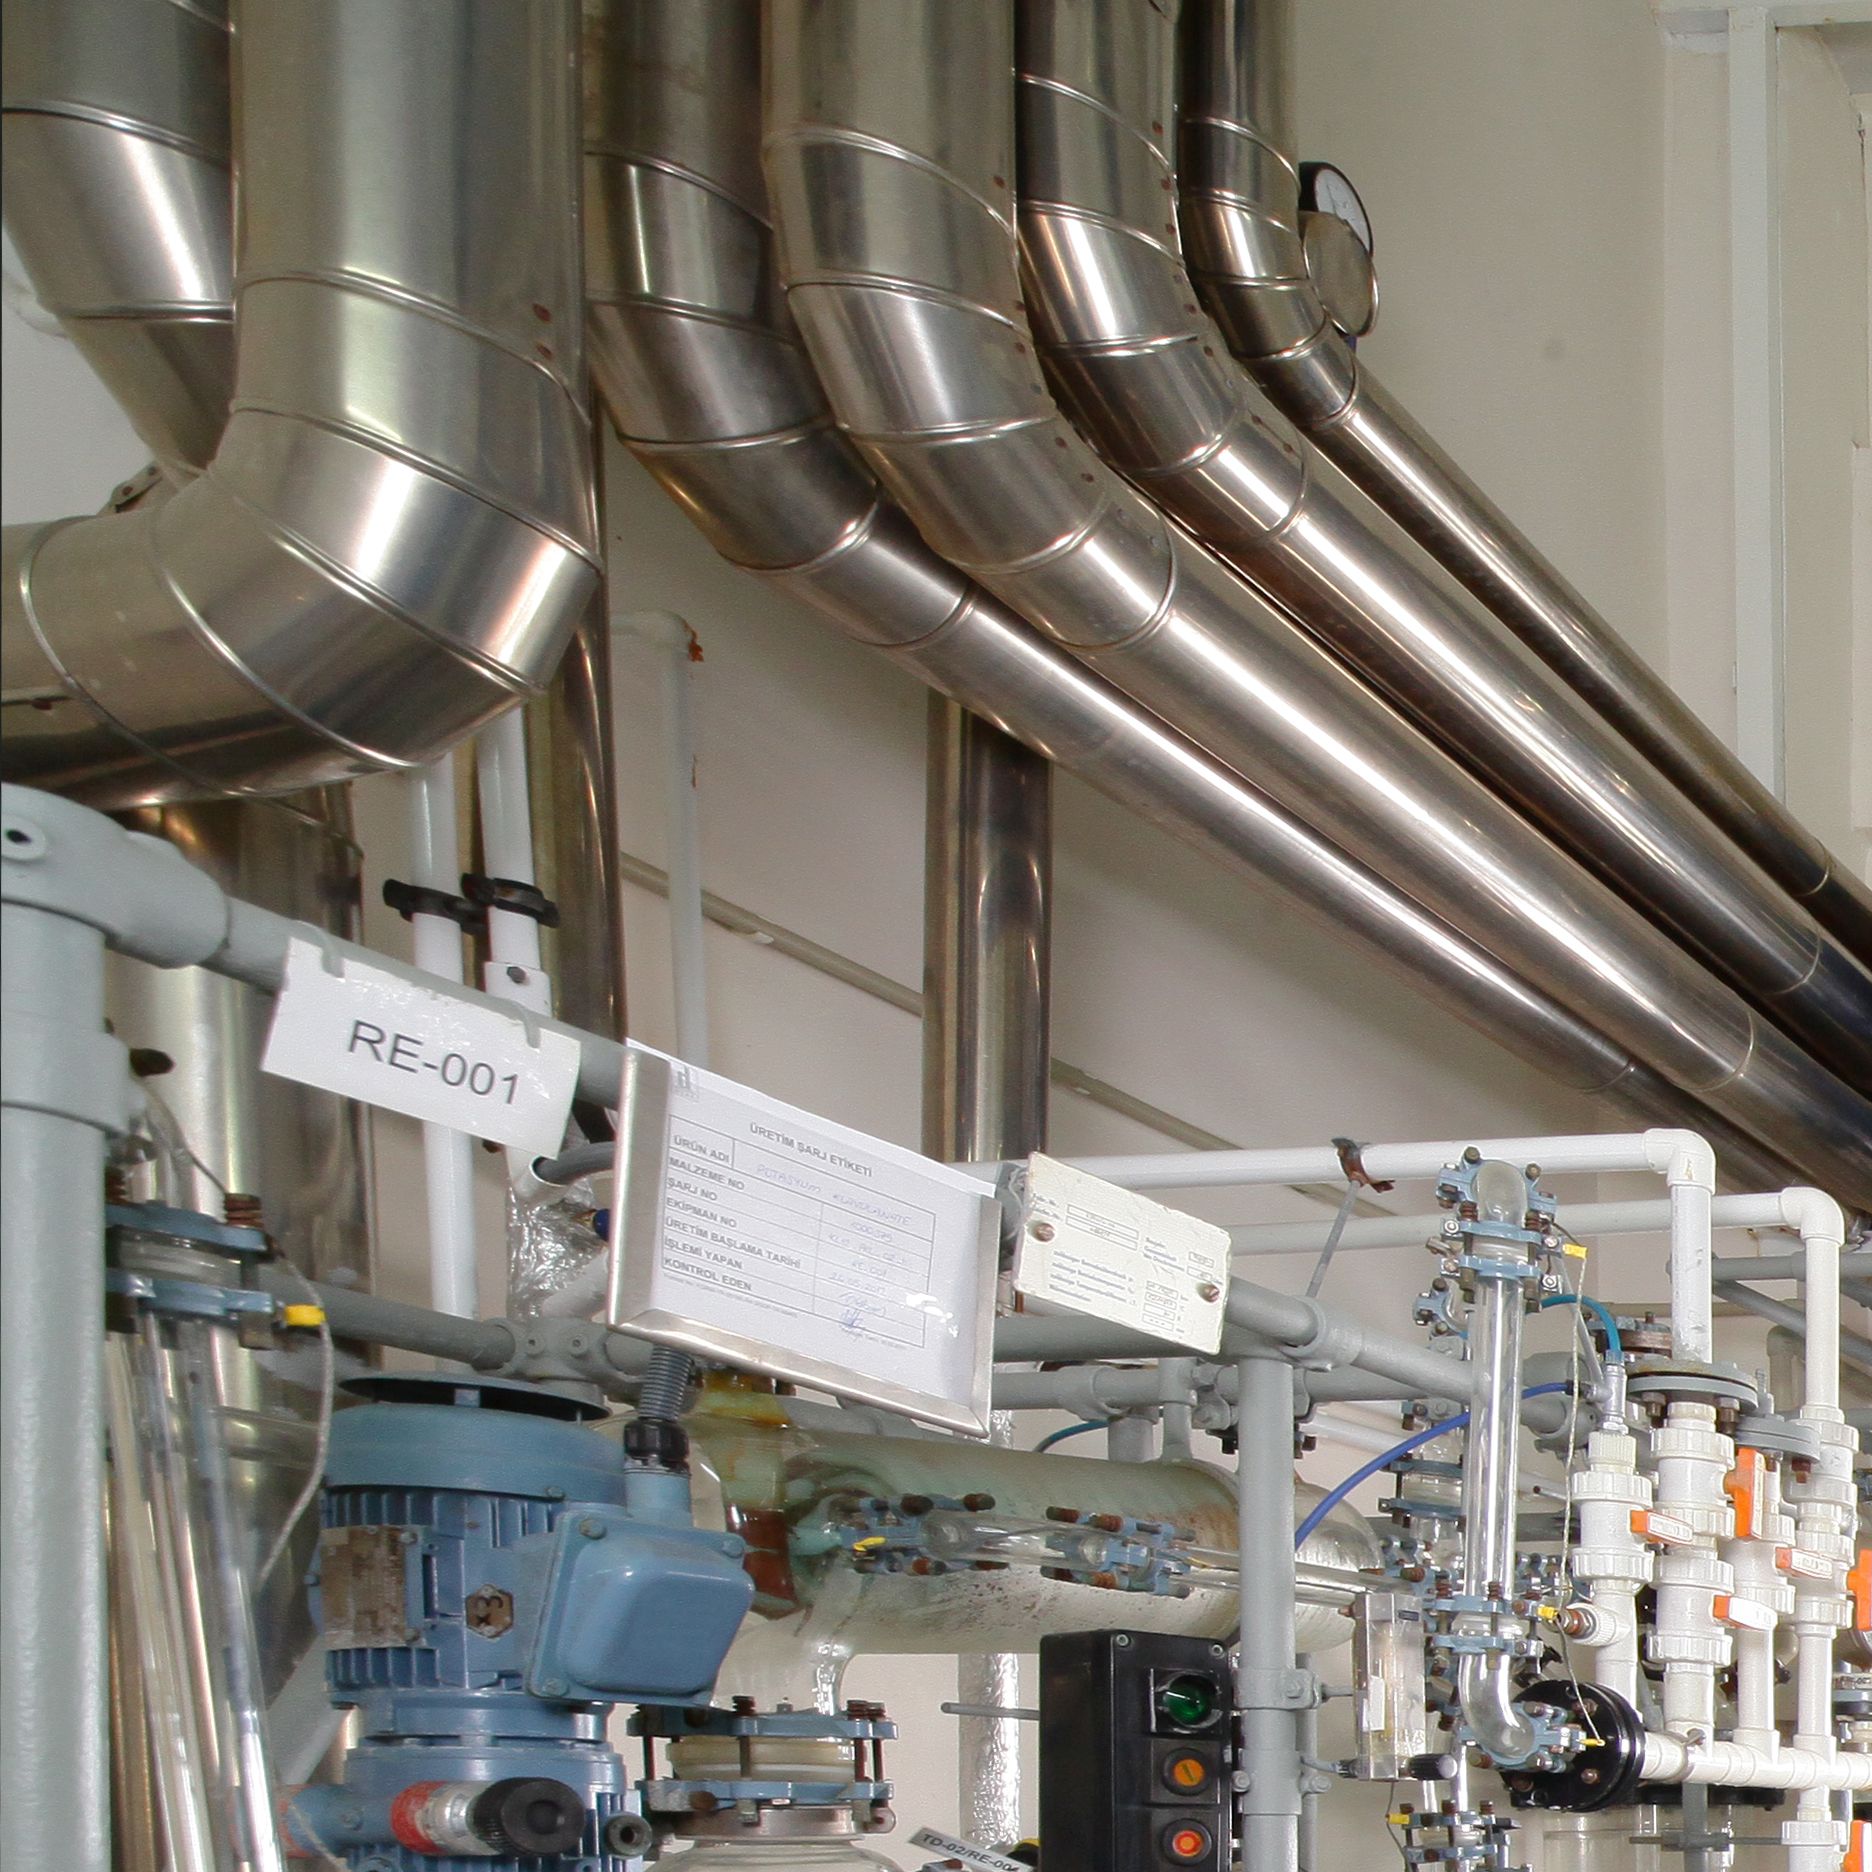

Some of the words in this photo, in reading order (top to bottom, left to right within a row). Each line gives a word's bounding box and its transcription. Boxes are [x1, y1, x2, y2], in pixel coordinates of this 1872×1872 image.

[348, 1019, 519, 1104] RE-001
[674, 1134, 707, 1157] ÜRÜN
[710, 1149, 730, 1163] ADI
[750, 1122, 794, 1150] ÜRETİM
[796, 1141, 827, 1161] ŞARJ
[829, 1152, 873, 1178] ETİKETİ
[667, 1177, 698, 1195] ŞARJ
[700, 1187, 718, 1201] NO
[668, 1156, 725, 1185] MALZEME
[727, 1176, 745, 1191] NO
[666, 1197, 718, 1223] EKİPMAN
[720, 1213, 737, 1228] NO
[664, 1235, 702, 1258] İŞLEMİ
[704, 1250, 743, 1270] YAPAN
[665, 1216, 709, 1240] ÜRETİM
[710, 1232, 763, 1258] BAŞLAMA
[766, 1249, 801, 1269] TARİHİ
[664, 1257, 719, 1281] KONTROL
[722, 1276, 752, 1292] EDEN
